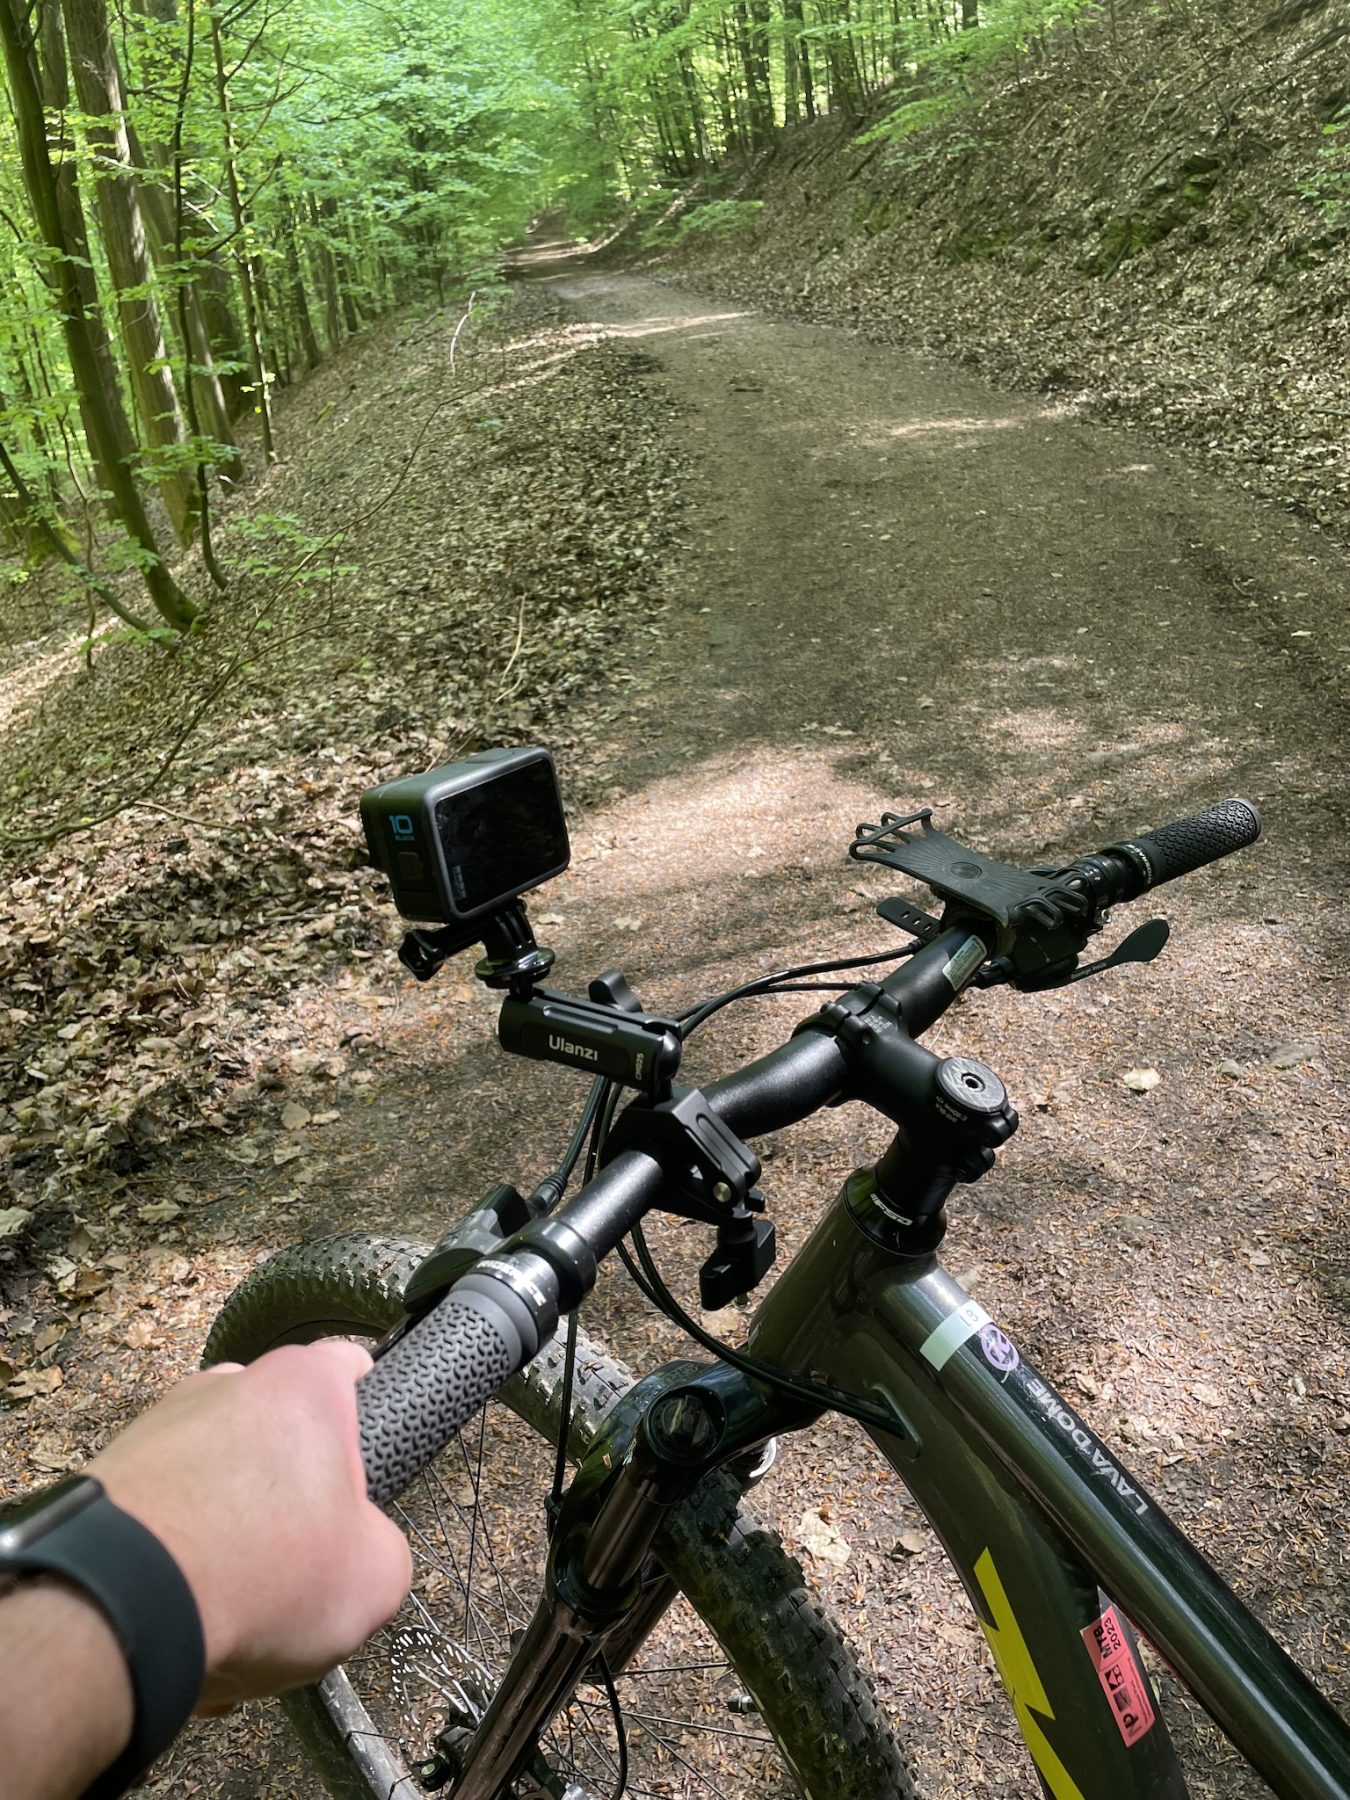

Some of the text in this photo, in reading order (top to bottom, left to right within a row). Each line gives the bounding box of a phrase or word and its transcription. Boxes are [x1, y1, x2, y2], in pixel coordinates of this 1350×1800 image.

[389, 815, 413, 834] 10
[548, 1034, 598, 1061] Ulanzi
[1093, 1626, 1112, 1659] MTB
[1104, 1617, 1122, 1651] 2023
